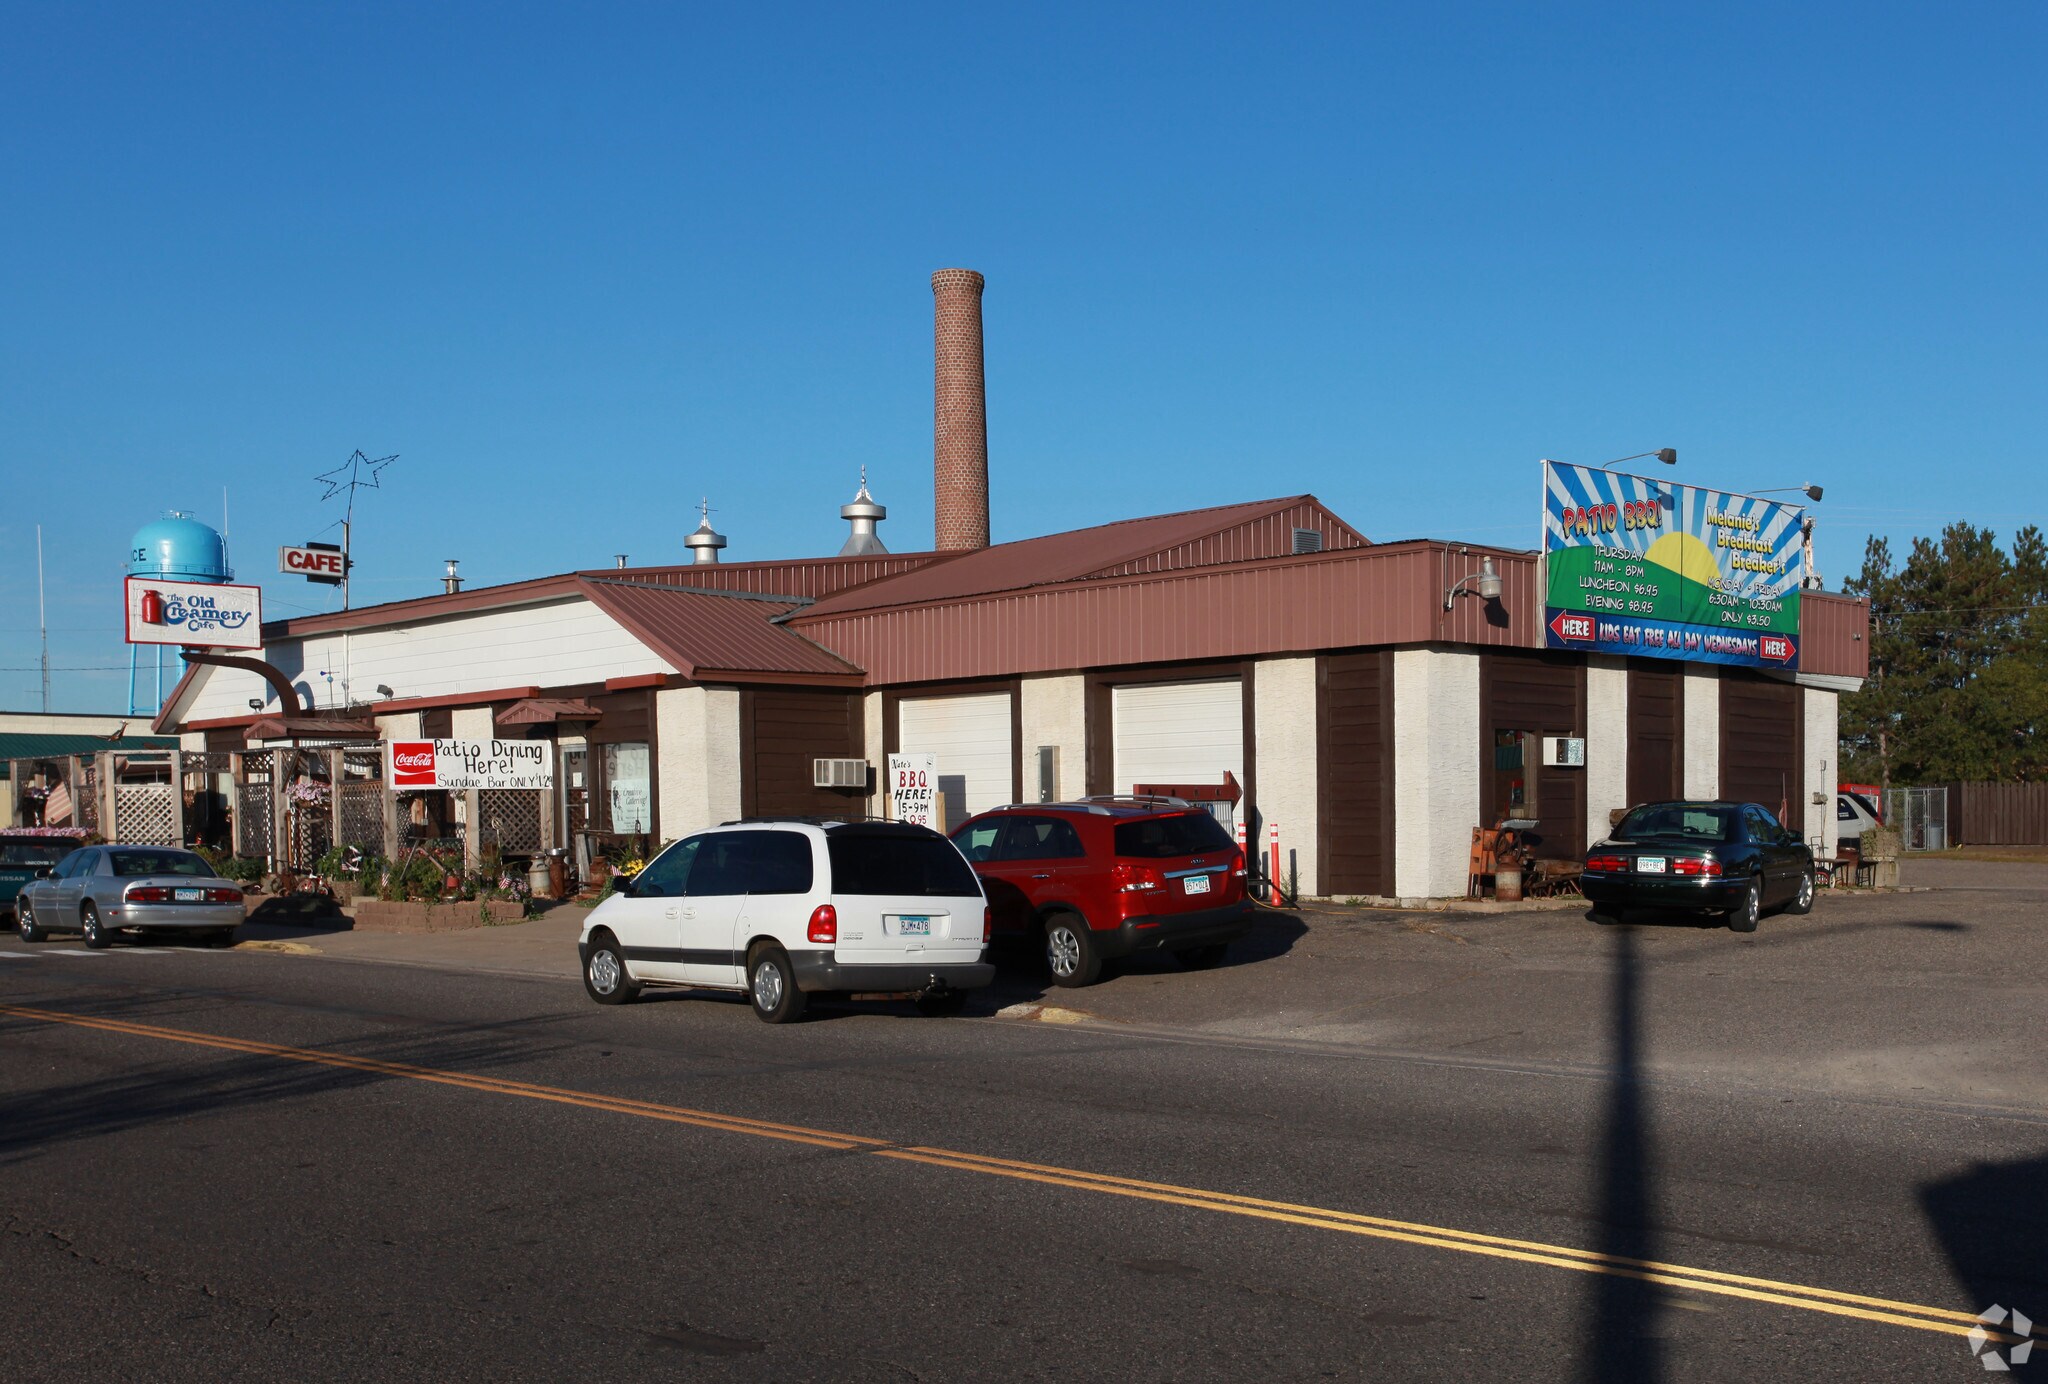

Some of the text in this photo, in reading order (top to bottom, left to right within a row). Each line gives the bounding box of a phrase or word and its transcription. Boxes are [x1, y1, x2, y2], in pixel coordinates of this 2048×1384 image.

[1563, 500, 1662, 538] PATIO BBQ!
[1707, 506, 1760, 532] Melanie's
[1717, 529, 1774, 554] Breakfast
[286, 551, 342, 572] CAFE
[1594, 544, 1645, 562] THURSDAY
[1594, 560, 1614, 574] 11AM
[1625, 565, 1644, 578] 8PM
[1732, 552, 1786, 575] Breaker's
[1579, 576, 1658, 597] LUNCHEON $6.95
[1708, 576, 1745, 591] MONDAY
[1754, 582, 1784, 597] FRIDAY
[167, 594, 215, 609] The Old
[1586, 595, 1653, 614] EVENING $8.95
[1708, 593, 1739, 607] 6:30AM
[1749, 599, 1783, 612] 10:30AM
[163, 602, 251, 629] Creamery
[1721, 611, 1771, 627] ONLY $3.50
[188, 619, 215, 632] Cafe
[1562, 619, 1590, 637] HERE
[1599, 623, 1758, 656] KIDS EAT FREE ALL DAY WEDNESDAYS
[1765, 640, 1786, 656] HERE
[396, 753, 433, 766] Coca-Cola
[434, 738, 480, 757] Patio
[491, 740, 542, 764] Dining
[465, 757, 514, 774] Here!
[892, 759, 911, 769] Nate's
[437, 773, 482, 788] Sundae
[488, 776, 506, 788] Bar
[510, 776, 535, 787] ONLY
[899, 770, 928, 788] BBQ
[894, 789, 932, 800] HERE!
